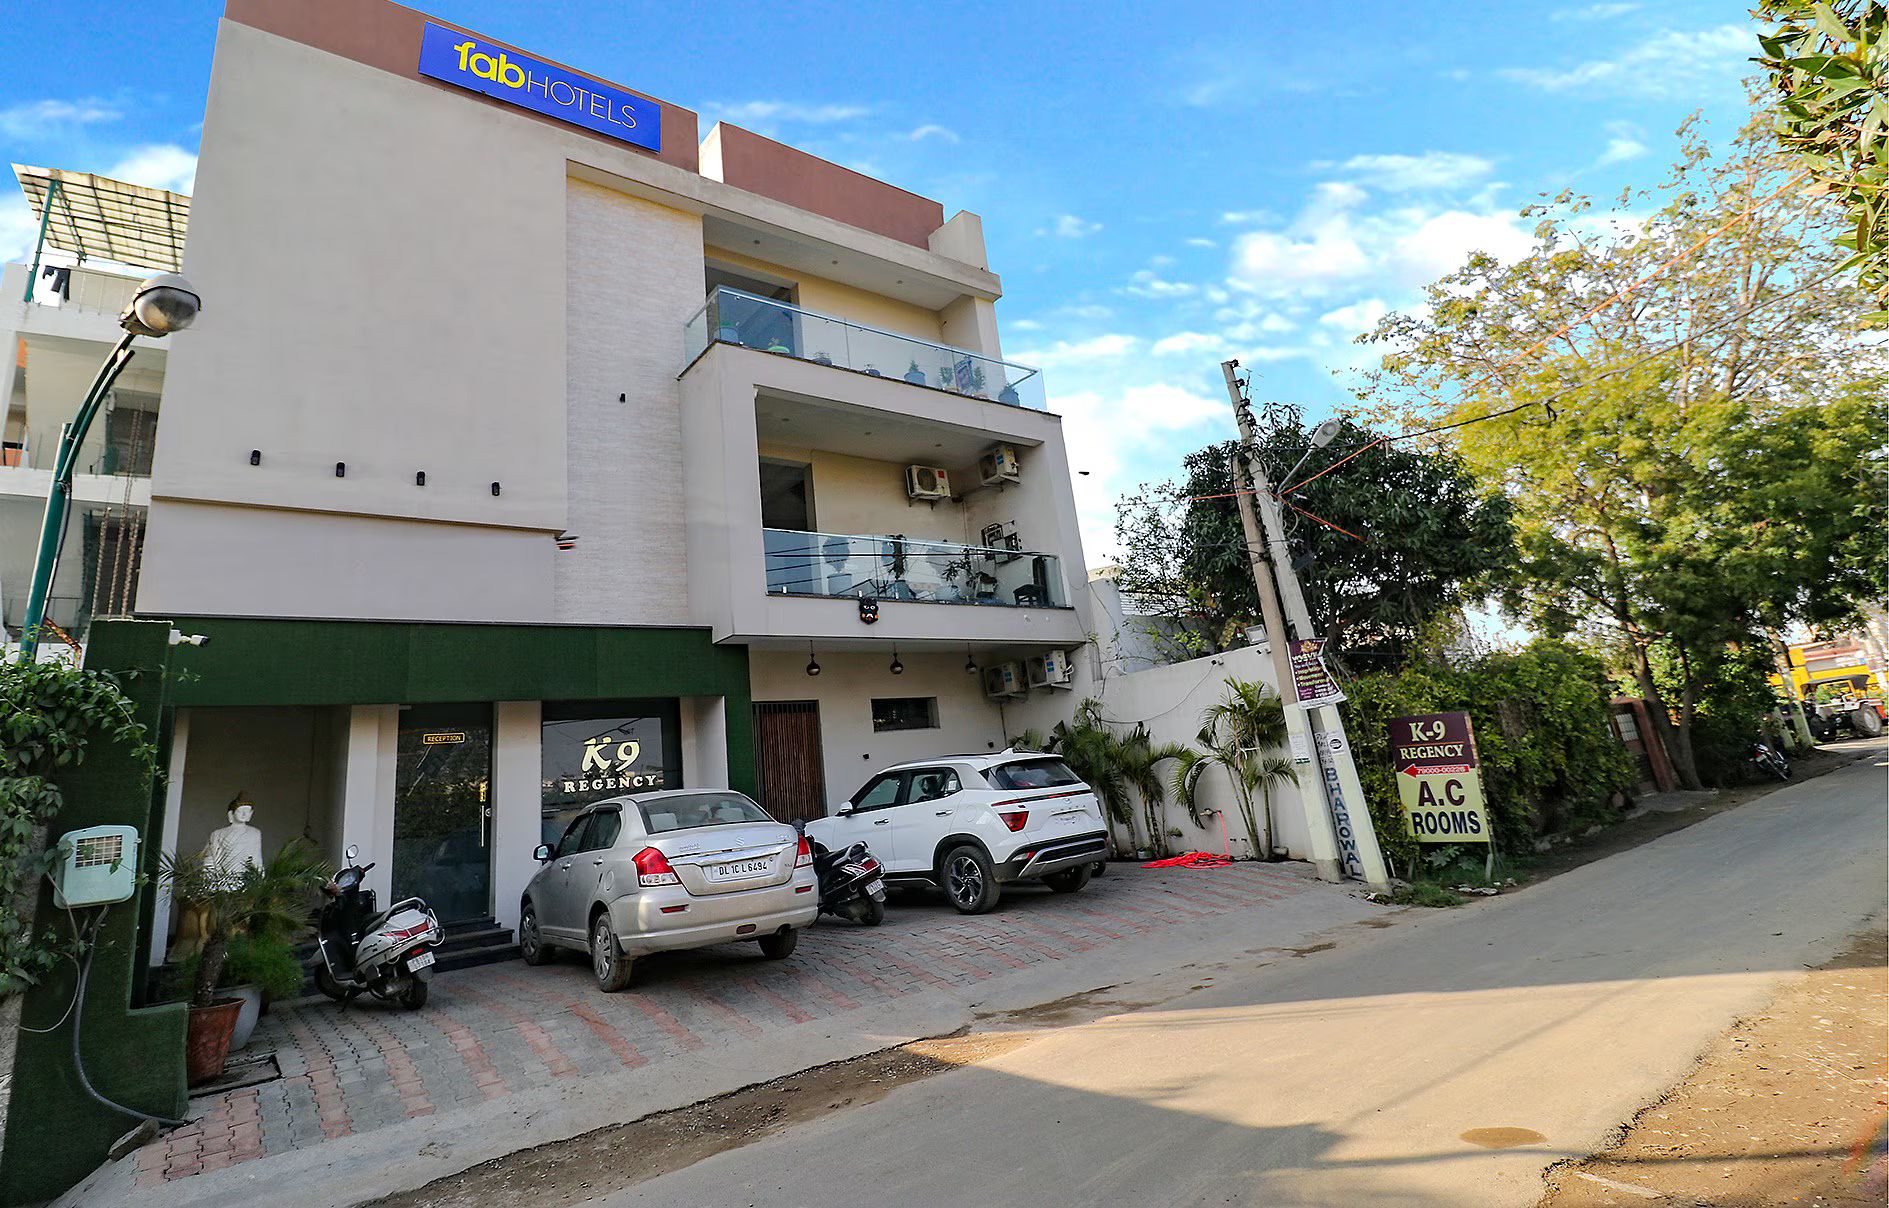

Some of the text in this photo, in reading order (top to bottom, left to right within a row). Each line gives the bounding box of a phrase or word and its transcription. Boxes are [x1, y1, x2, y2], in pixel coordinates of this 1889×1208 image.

[1408, 720, 1446, 742] K-9
[1400, 744, 1464, 760] REGENCY
[563, 775, 657, 793] REGENCY
[1418, 779, 1466, 807] A.C
[1411, 811, 1481, 835] ROOMS
[719, 866, 729, 876] DL
